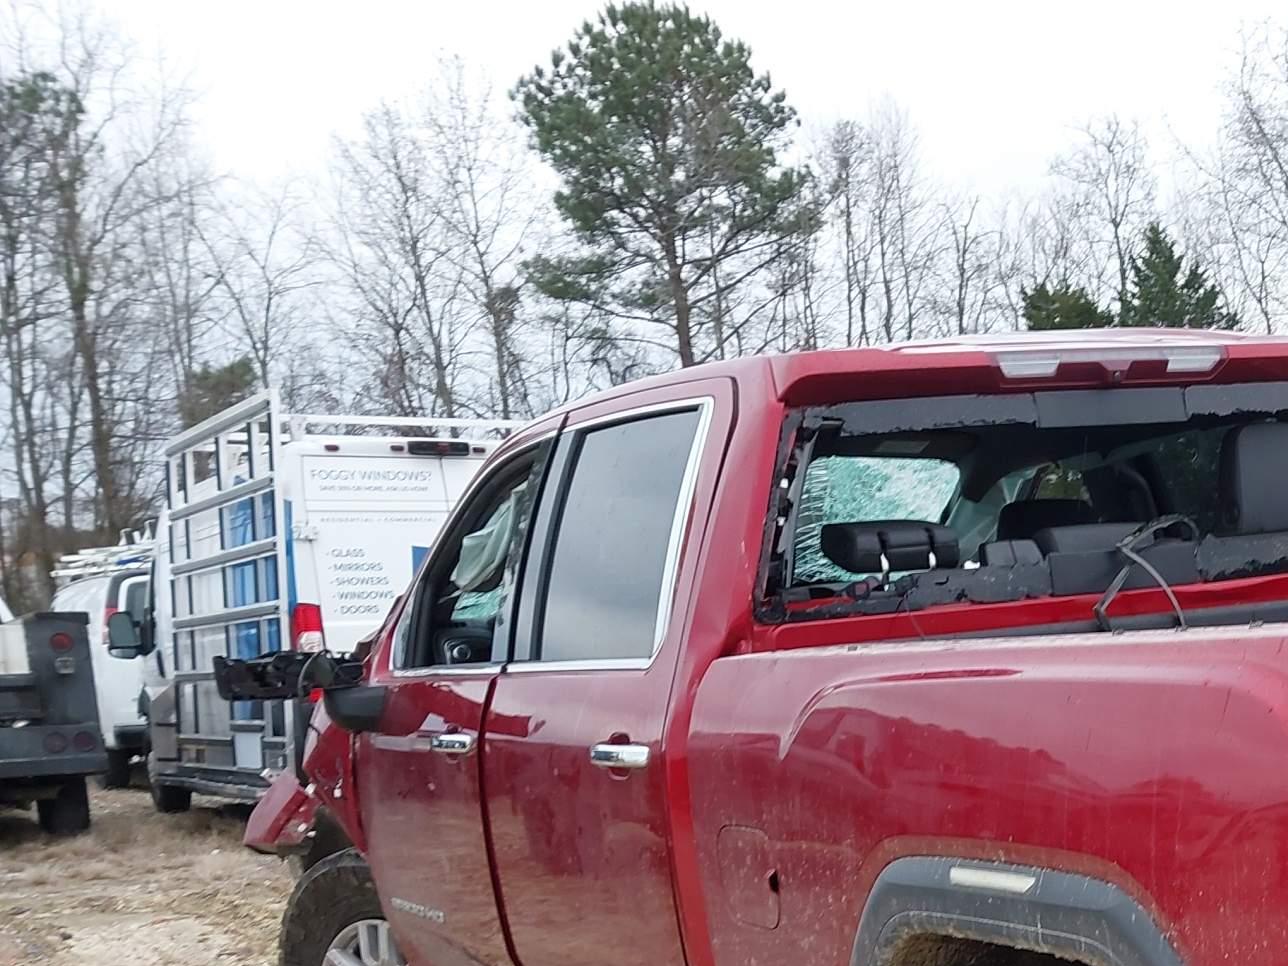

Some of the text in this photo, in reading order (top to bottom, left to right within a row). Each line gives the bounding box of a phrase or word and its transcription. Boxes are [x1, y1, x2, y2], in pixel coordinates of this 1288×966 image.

[311, 469, 432, 481] FOGGY WINDOWS?
[331, 548, 366, 557] GLASS
[334, 562, 383, 571] MIRRORS
[335, 576, 389, 585] SHOWERS
[338, 590, 394, 599] WINDOWS
[341, 605, 380, 614] DOORS
